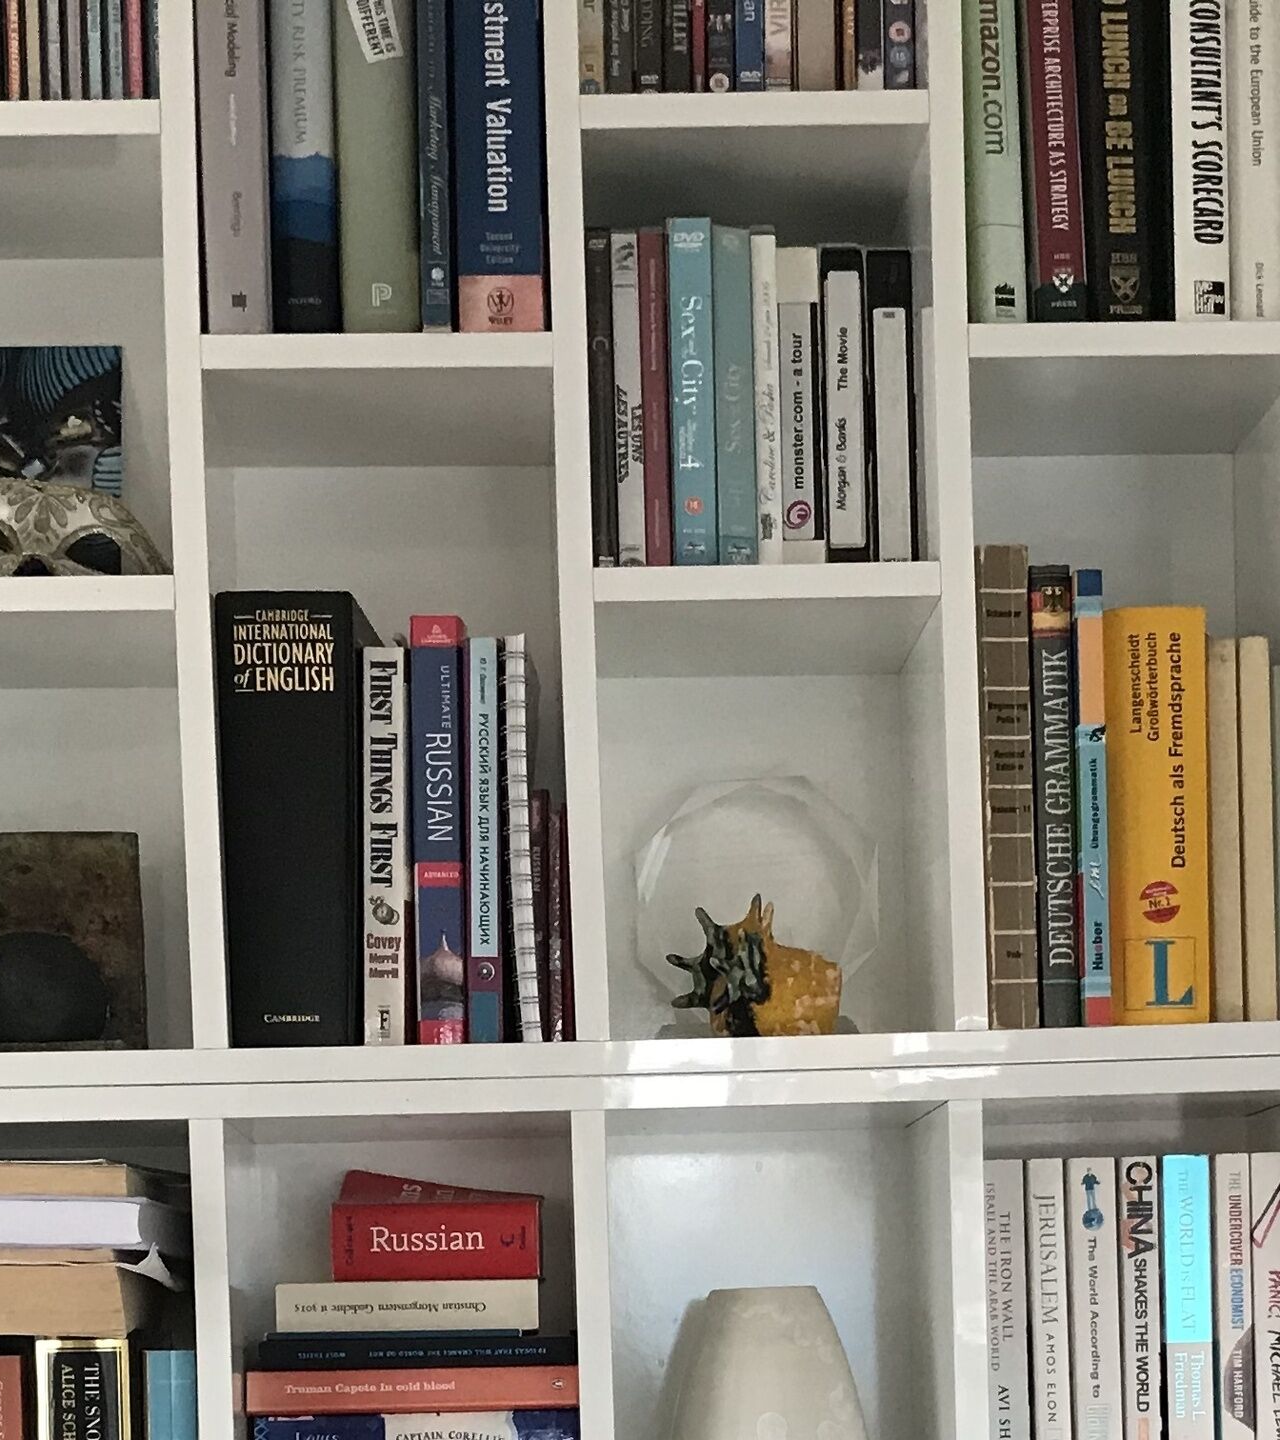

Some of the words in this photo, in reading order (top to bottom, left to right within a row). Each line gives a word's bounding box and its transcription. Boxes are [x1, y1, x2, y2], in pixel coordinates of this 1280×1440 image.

[1100, 11, 1131, 89] LUNCH
[1249, 25, 1261, 37] to
[1250, 42, 1263, 59] the
[1044, 57, 1067, 149] ARCHITECTURE
[1250, 62, 1264, 126] European
[486, 98, 514, 213] Valuation
[1105, 120, 1133, 150] BE
[1251, 130, 1263, 167] Union
[1049, 152, 1066, 168] AS
[1050, 170, 1070, 231] STRATEGY
[1107, 156, 1136, 234] LUNCH
[1192, 140, 1227, 244] SCORECARD
[794, 333, 805, 362] tour
[838, 327, 849, 365] Movie
[795, 367, 804, 376] a
[838, 371, 848, 391] The
[794, 393, 806, 490] monster.com
[234, 623, 333, 642] INTERNATIONAL
[256, 609, 310, 624] CAMBRIDGE
[234, 643, 334, 666] DICTIONARY
[234, 669, 253, 689] of
[256, 667, 334, 692] ENGLISH
[1128, 633, 1143, 734] Langenscheidt
[1147, 632, 1160, 742] Großwörterbuch
[1167, 632, 1186, 759] Fremdsprache
[1042, 649, 1074, 817] GRAMMATIK
[426, 732, 453, 842] RUSSIAN
[1170, 762, 1186, 790] als
[1170, 795, 1186, 869] Deutsch
[1042, 823, 1075, 968] DEUTSCHE
[366, 932, 401, 952] Covey
[999, 1211, 1011, 1244] THE
[1125, 1161, 1157, 1260] CHINA
[370, 1225, 485, 1253] Russian
[1033, 1194, 1058, 1324] JERUSALEM
[1000, 1251, 1013, 1293] IRON
[1133, 1258, 1148, 1315] SHAKES
[1001, 1299, 1014, 1342] WALL
[1134, 1318, 1148, 1353] THE
[84, 1362, 100, 1401] THE
[998, 1384, 1010, 1414] AVI
[1135, 1355, 1150, 1413] WORLD
